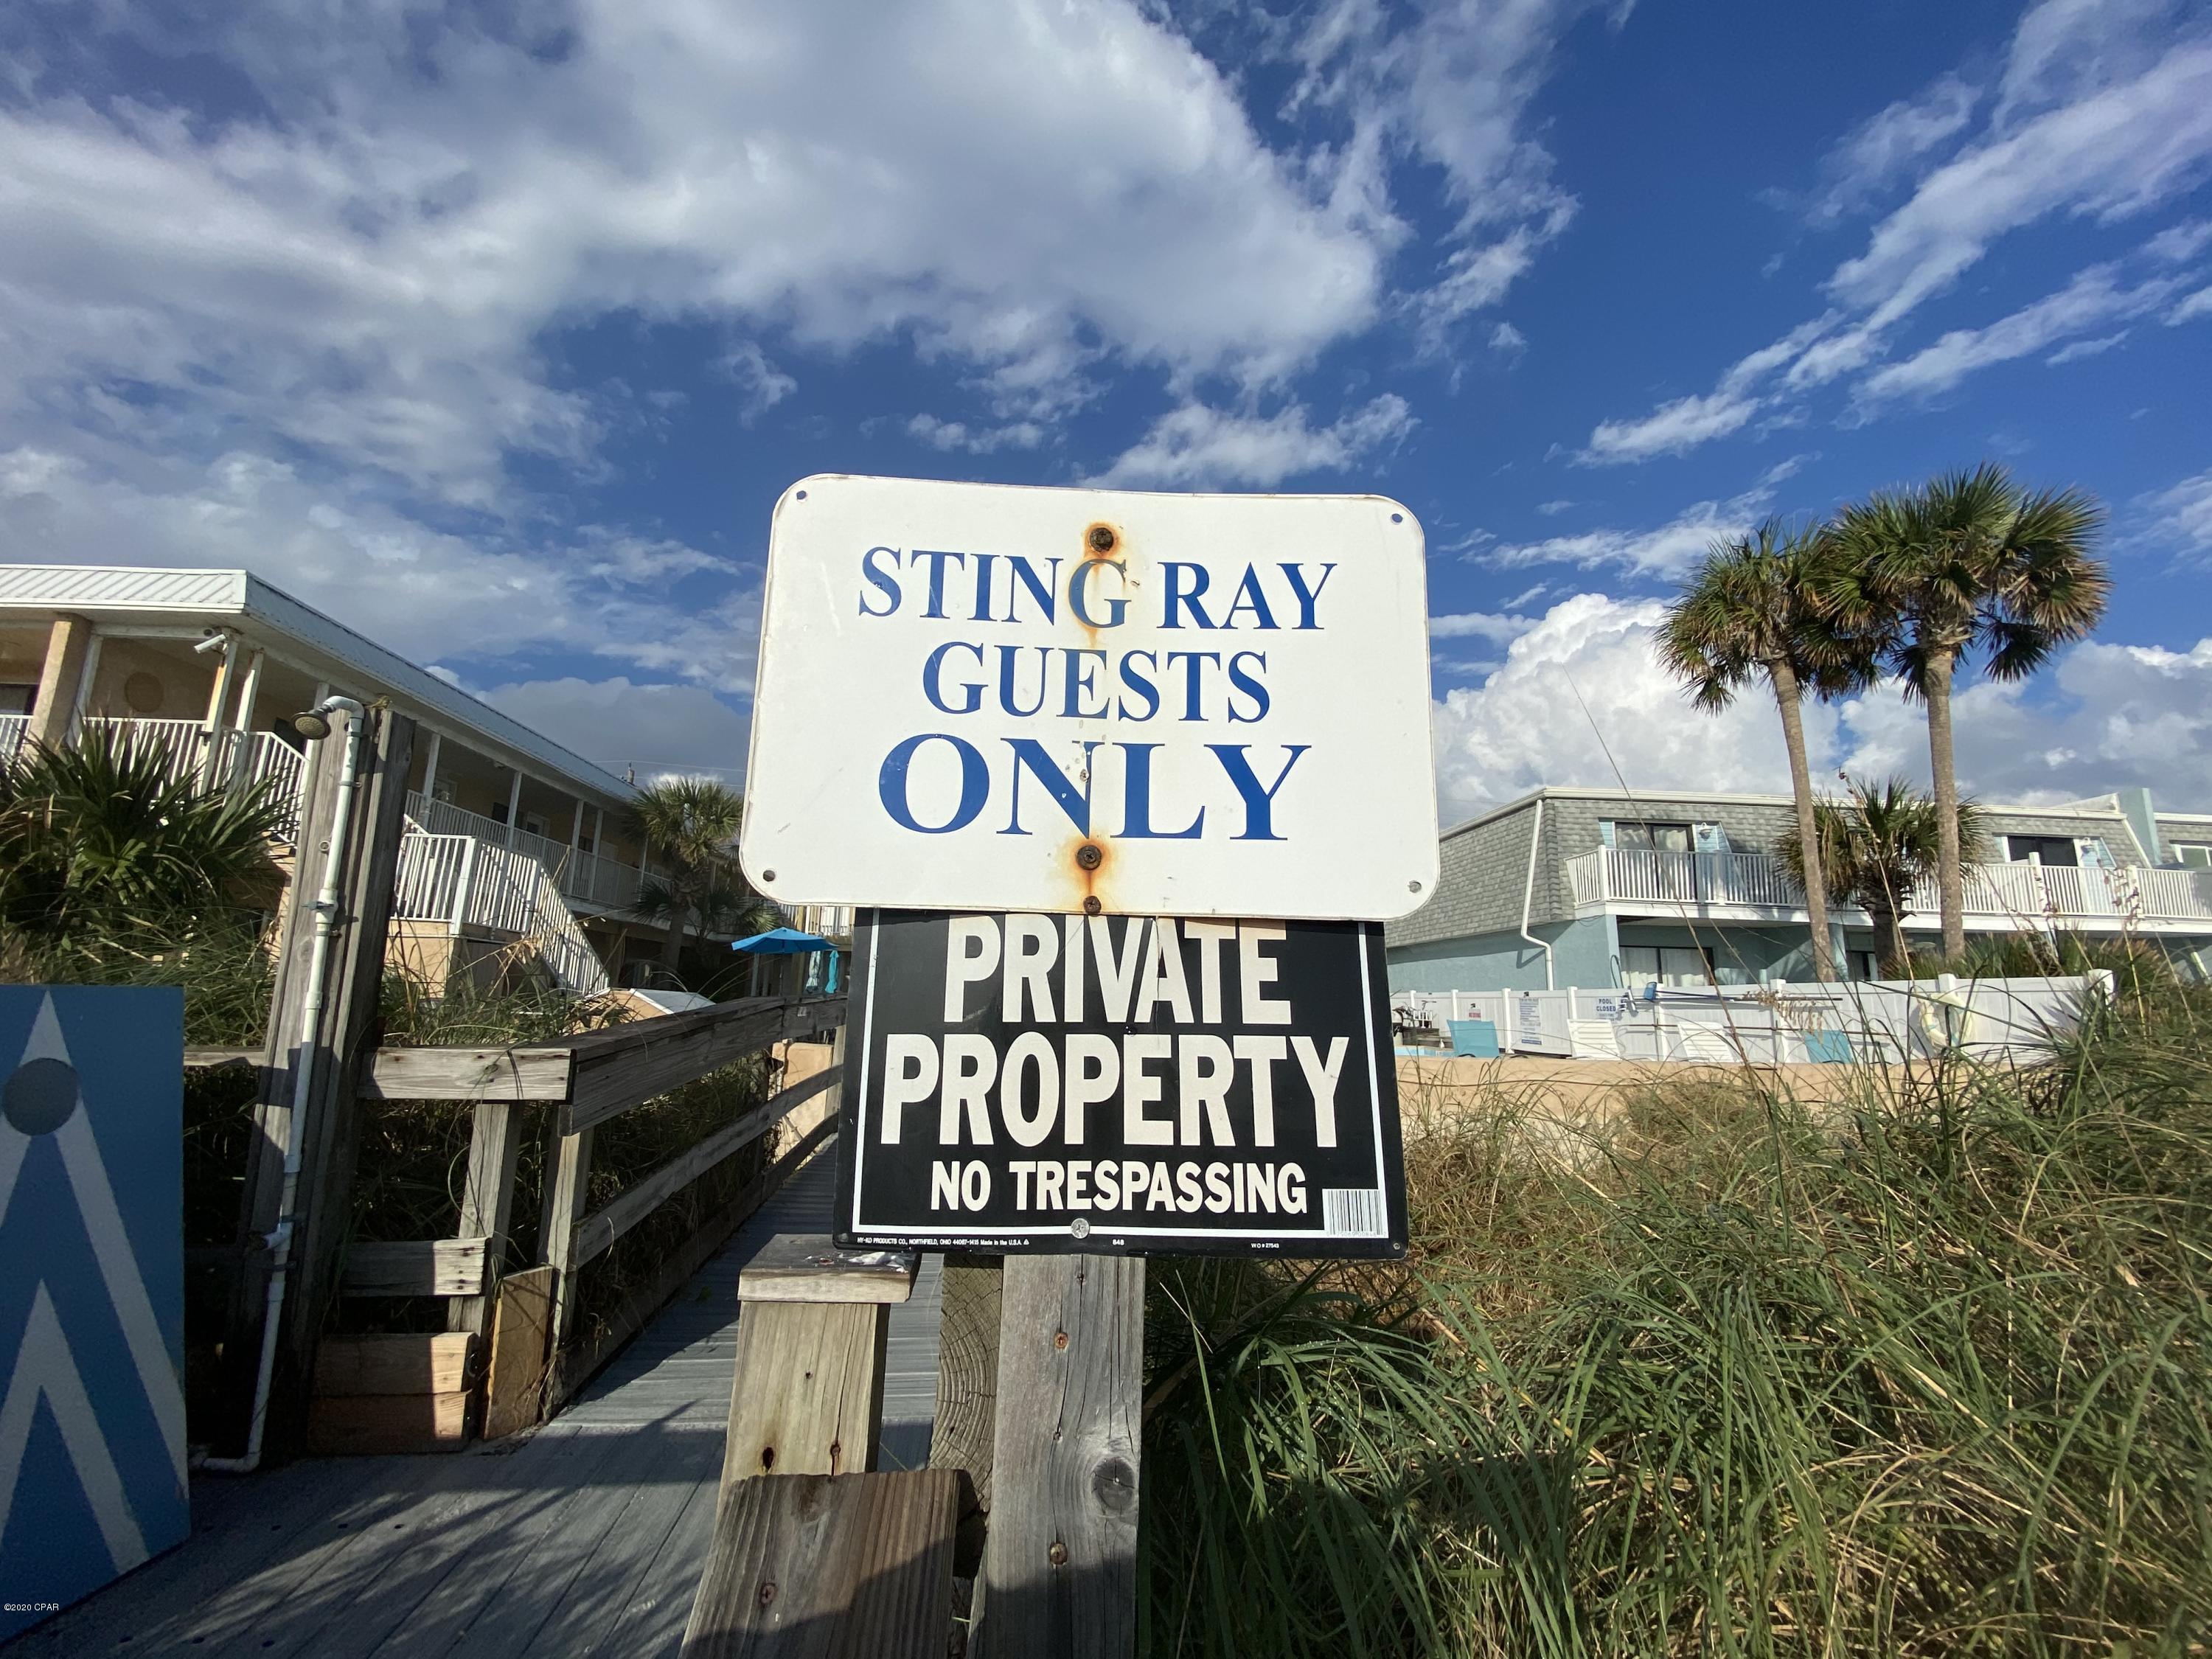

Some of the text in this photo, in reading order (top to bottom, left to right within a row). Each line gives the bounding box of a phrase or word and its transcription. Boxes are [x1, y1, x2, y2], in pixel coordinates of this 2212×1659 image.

[858, 546, 1338, 630] STING RAY
[922, 641, 1270, 723] GUESTS
[878, 733, 1312, 841] ONLY
[944, 914, 1292, 1025] PRIVATE
[880, 1031, 1350, 1148] PROPERTY
[931, 1160, 1308, 1214] NO TRESPASSING
[909, 1238, 939, 1246] NORTHFIELD,
